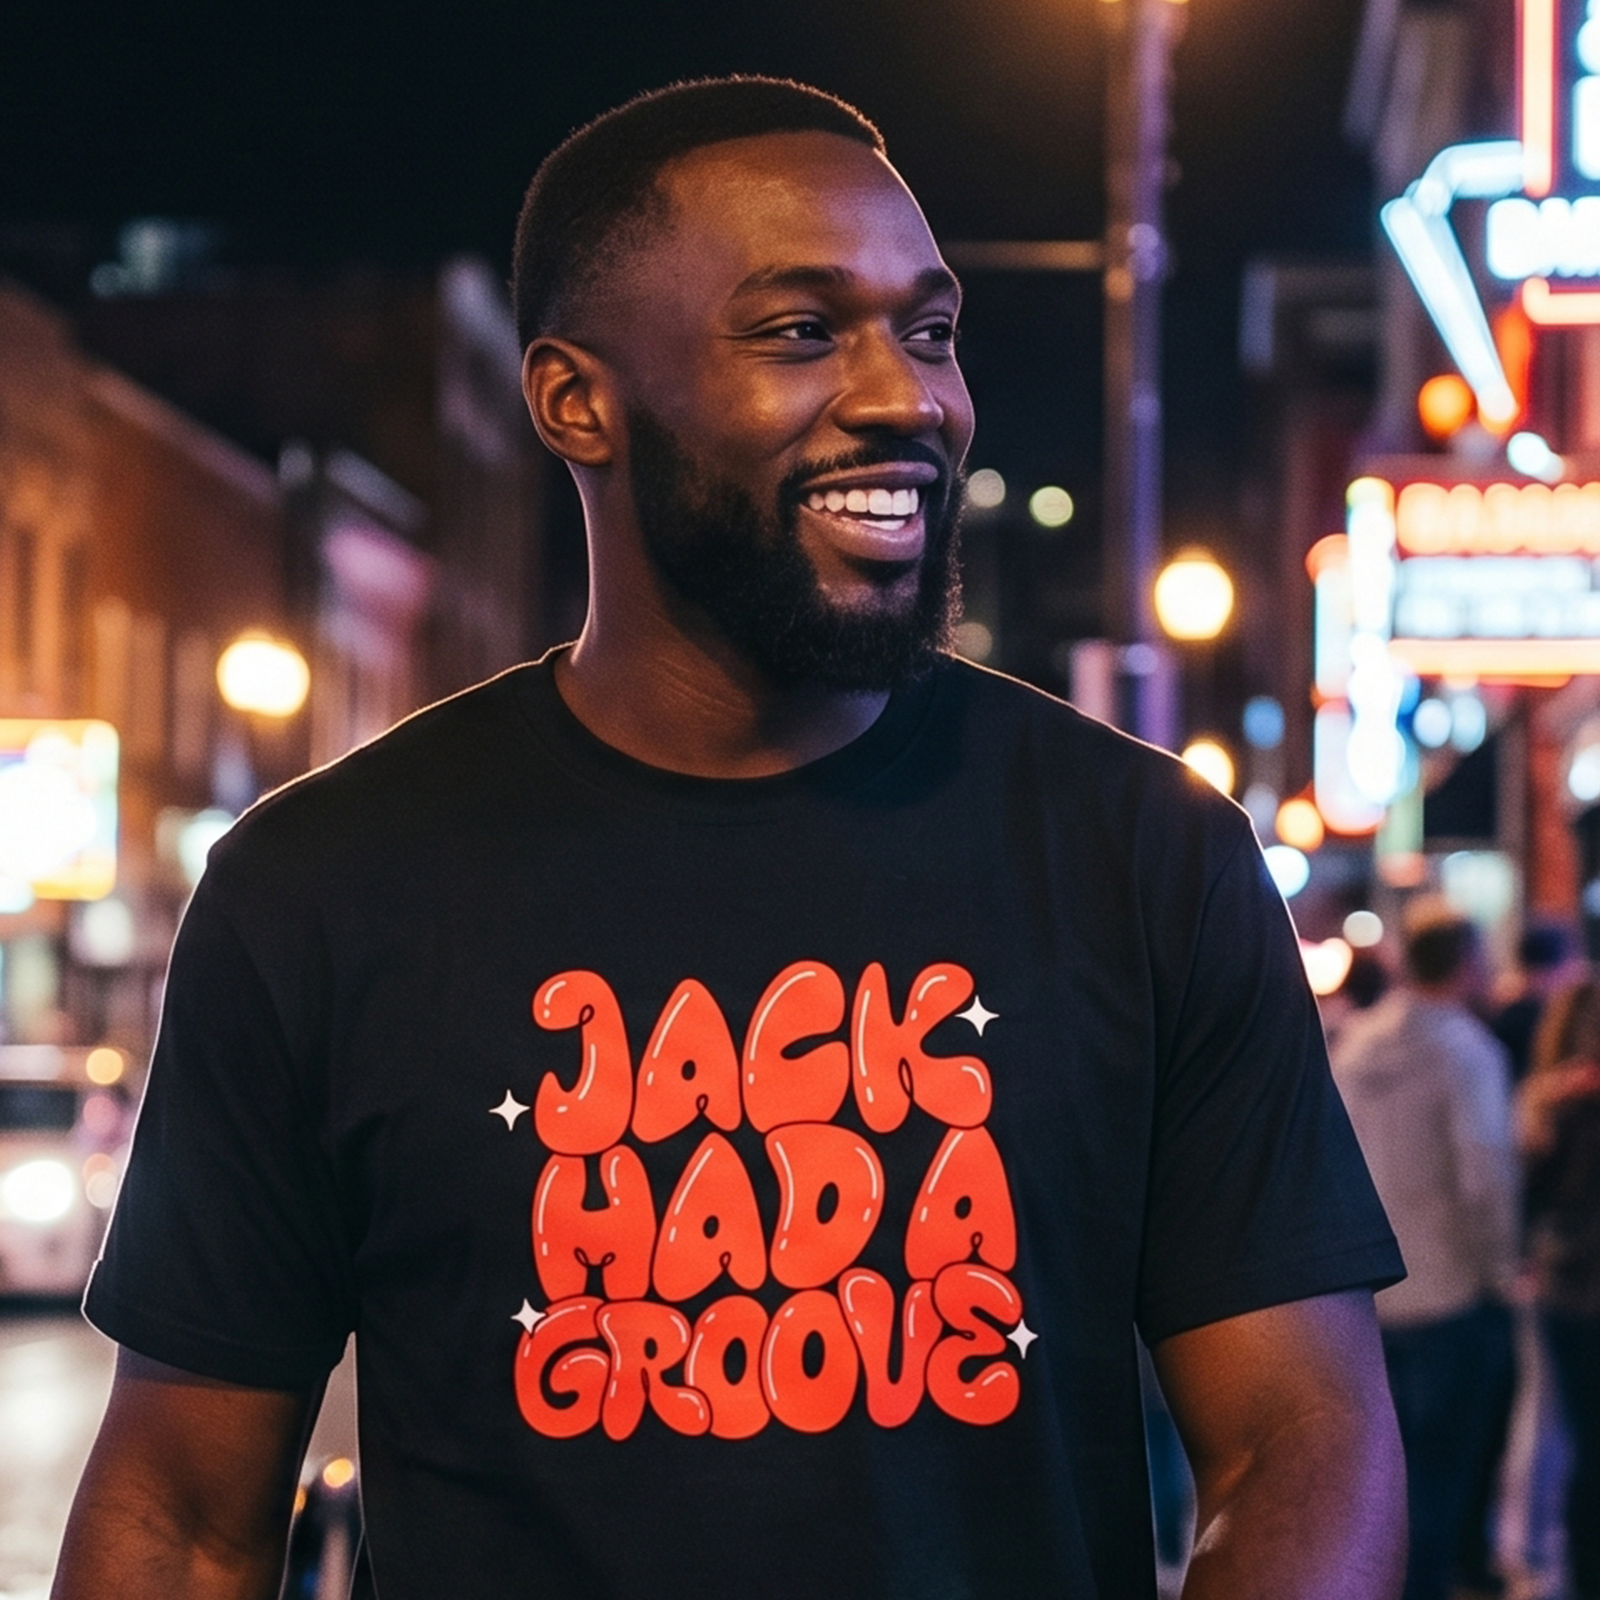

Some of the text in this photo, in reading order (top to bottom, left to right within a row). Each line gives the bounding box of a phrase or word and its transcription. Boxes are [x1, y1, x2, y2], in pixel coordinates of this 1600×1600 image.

[532, 960, 993, 1157] JACK
[532, 1121, 1018, 1303] HAD A
[514, 1262, 1023, 1441] GROOVE
